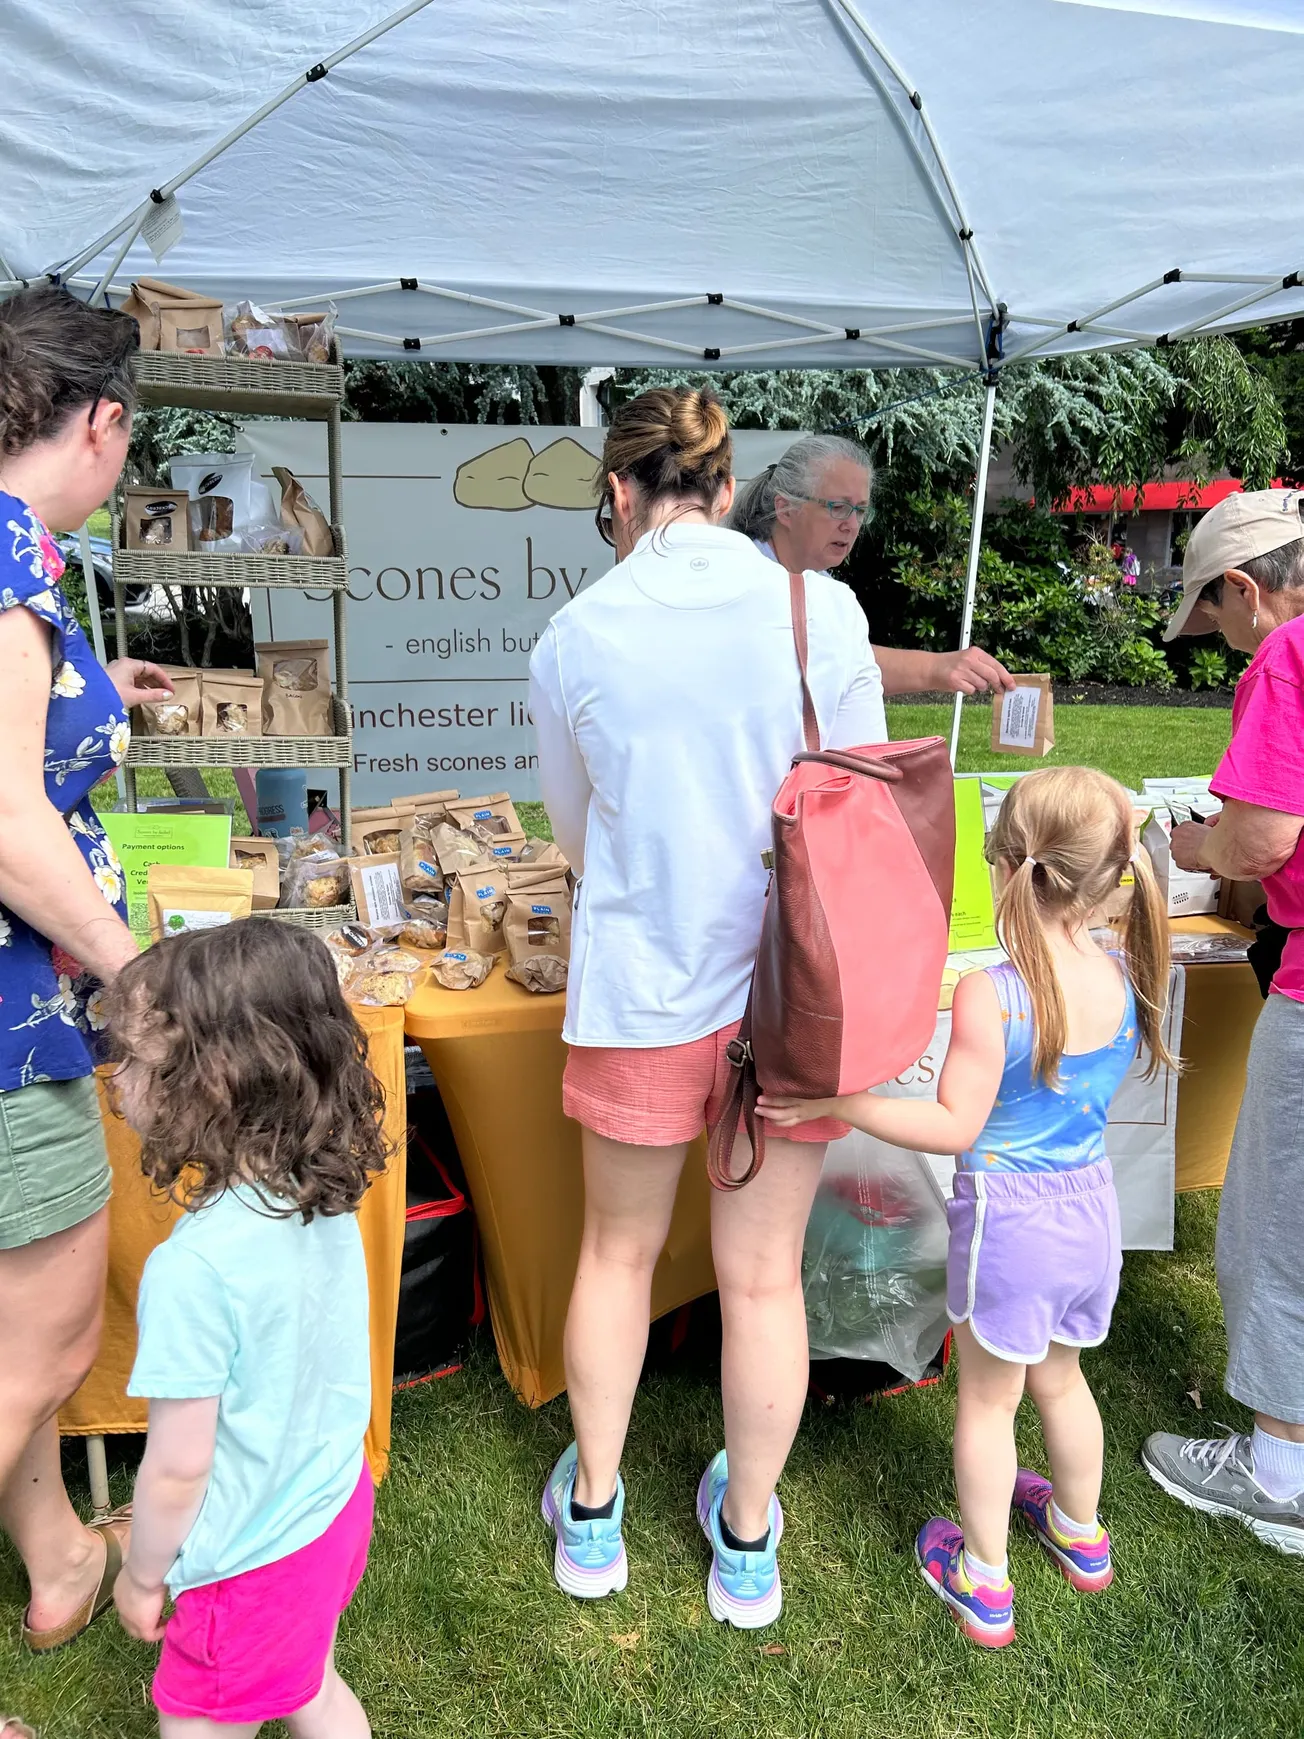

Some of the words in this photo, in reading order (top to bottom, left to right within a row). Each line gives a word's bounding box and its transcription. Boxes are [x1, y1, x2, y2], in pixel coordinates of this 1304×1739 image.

[302, 566, 501, 601] cones
[405, 628, 491, 660] english
[353, 753, 419, 773] Fresh
[427, 756, 507, 772] scones
[474, 811, 491, 819] PLAIN
[122, 843, 155, 851] Payment
[156, 843, 185, 851] options
[420, 862, 436, 876] PLAIN
[477, 887, 494, 898] PLAIN
